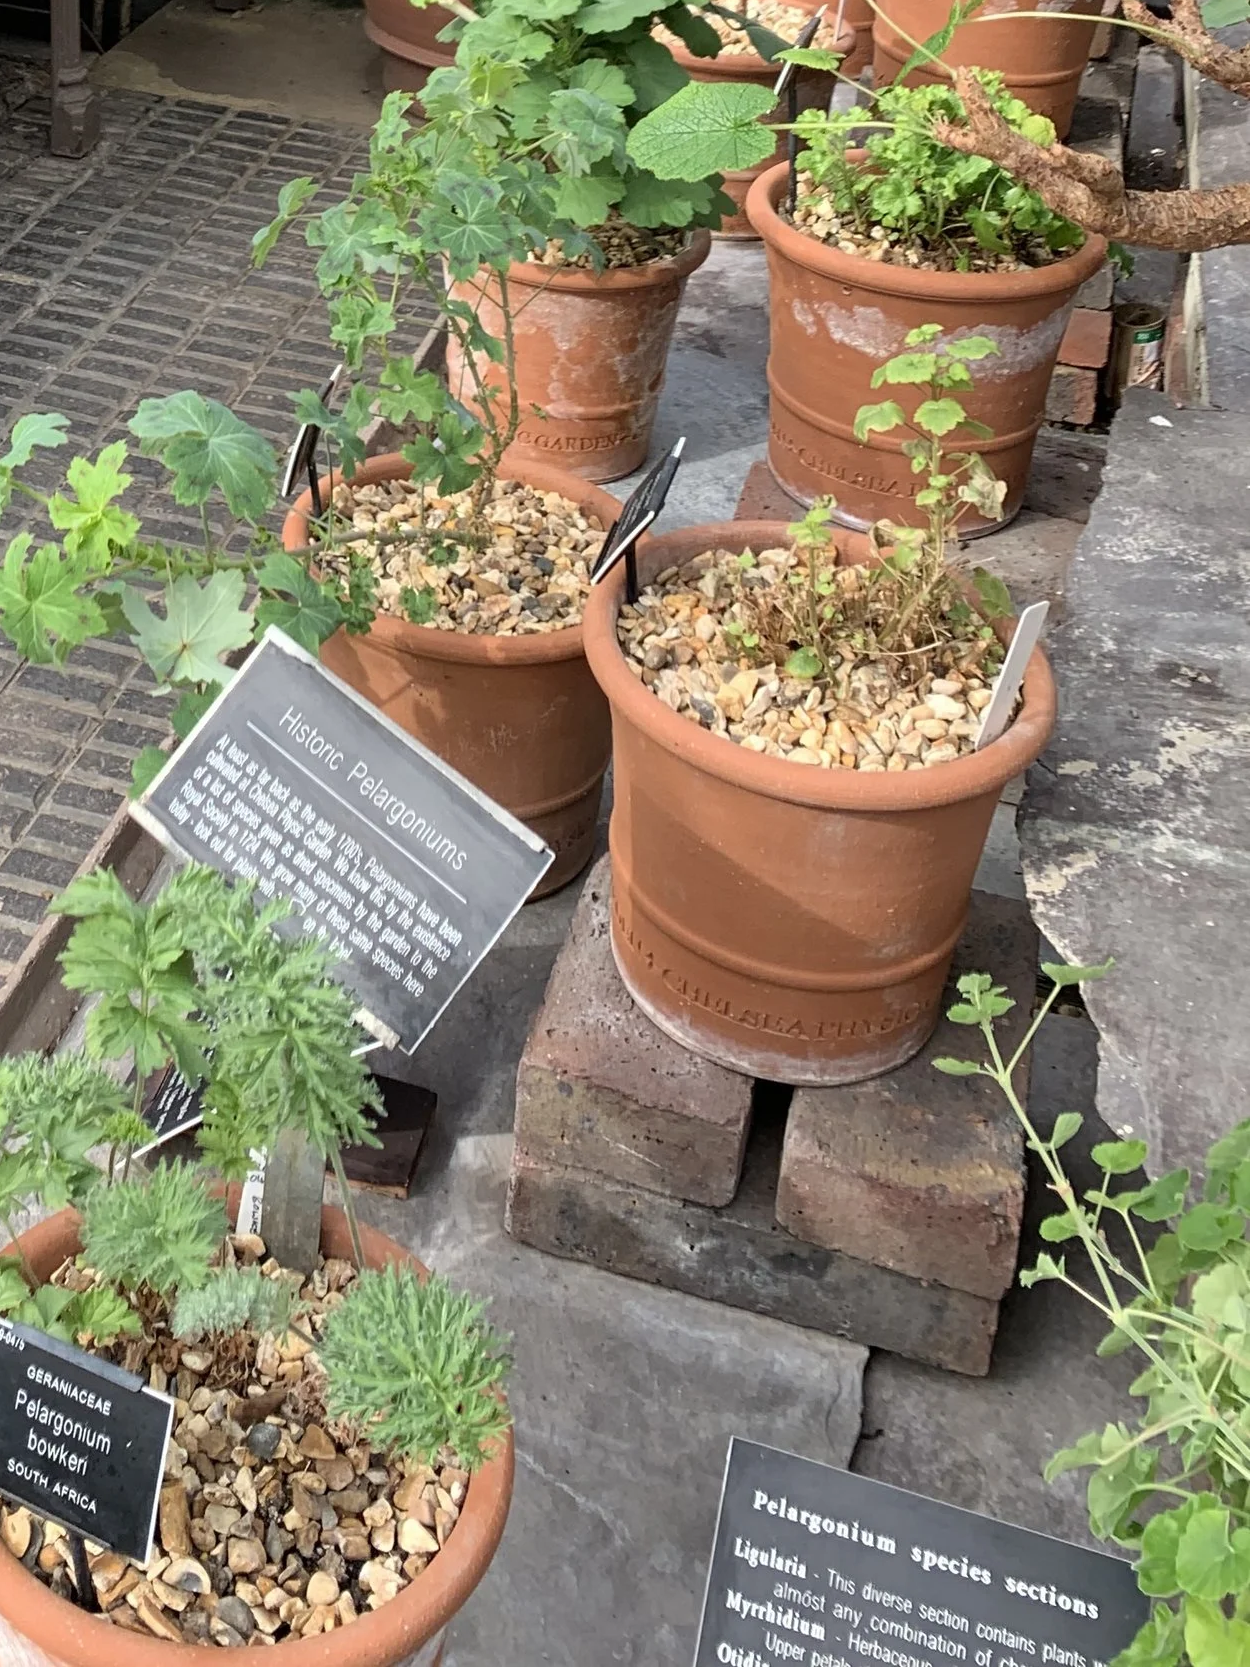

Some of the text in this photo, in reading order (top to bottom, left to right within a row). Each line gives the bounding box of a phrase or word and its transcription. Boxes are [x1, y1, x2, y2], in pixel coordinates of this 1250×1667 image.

[534, 430, 621, 451] GARDEN
[216, 734, 230, 751] At
[227, 741, 249, 767] least
[246, 761, 258, 776] as
[257, 767, 271, 786] far
[269, 777, 290, 803] back
[289, 797, 301, 812] as
[301, 804, 316, 824] the
[310, 818, 337, 844] early
[364, 855, 418, 909] Pelargoniums
[417, 900, 439, 927] have
[439, 917, 462, 947] been
[279, 706, 343, 770] Historic
[347, 761, 467, 870] Pelargoniums
[169, 796, 191, 825] today
[194, 818, 212, 842] look
[210, 835, 226, 854] out
[223, 844, 236, 863] for
[303, 916, 316, 933] on
[180, 779, 206, 807] Royal
[202, 798, 232, 832] Society
[228, 824, 239, 838] in
[260, 847, 275, 869] We
[271, 863, 296, 886] grow
[294, 880, 318, 908] many
[316, 899, 331, 914] of
[326, 905, 350, 934] these
[349, 928, 373, 953] same
[372, 946, 404, 980] species
[403, 971, 424, 997] here
[193, 766, 437, 979] of a list of species given as dried specimens by the garden to the
[206, 750, 242, 784] cultivated
[238, 777, 251, 792] at
[249, 783, 279, 817] Chelsea
[277, 807, 304, 838] Physic
[334, 853, 349, 876] We
[347, 866, 371, 894] know
[370, 885, 386, 907] this
[385, 898, 399, 919] by
[397, 910, 413, 930] the
[412, 924, 450, 961] existence
[15, 1388, 110, 1454] Pelargonium
[27, 1365, 111, 1415] GERANIACEAE
[8, 1458, 96, 1513] SOUTH AFRICA
[28, 1428, 87, 1475] bowkeri
[735, 1538, 806, 1578] Ligularia
[828, 1568, 855, 1595] This
[862, 1583, 912, 1614] diverse
[918, 1604, 969, 1633] section
[976, 1623, 1035, 1654] contains
[1042, 1643, 1086, 1667] plants
[753, 1491, 1098, 1619] Pelargonium species sections
[726, 1589, 825, 1640] Myrrhidium
[766, 1631, 806, 1661] Upper
[773, 1582, 825, 1612] almost
[833, 1603, 862, 1628] any
[870, 1616, 966, 1659] combination
[975, 1649, 993, 1667] of
